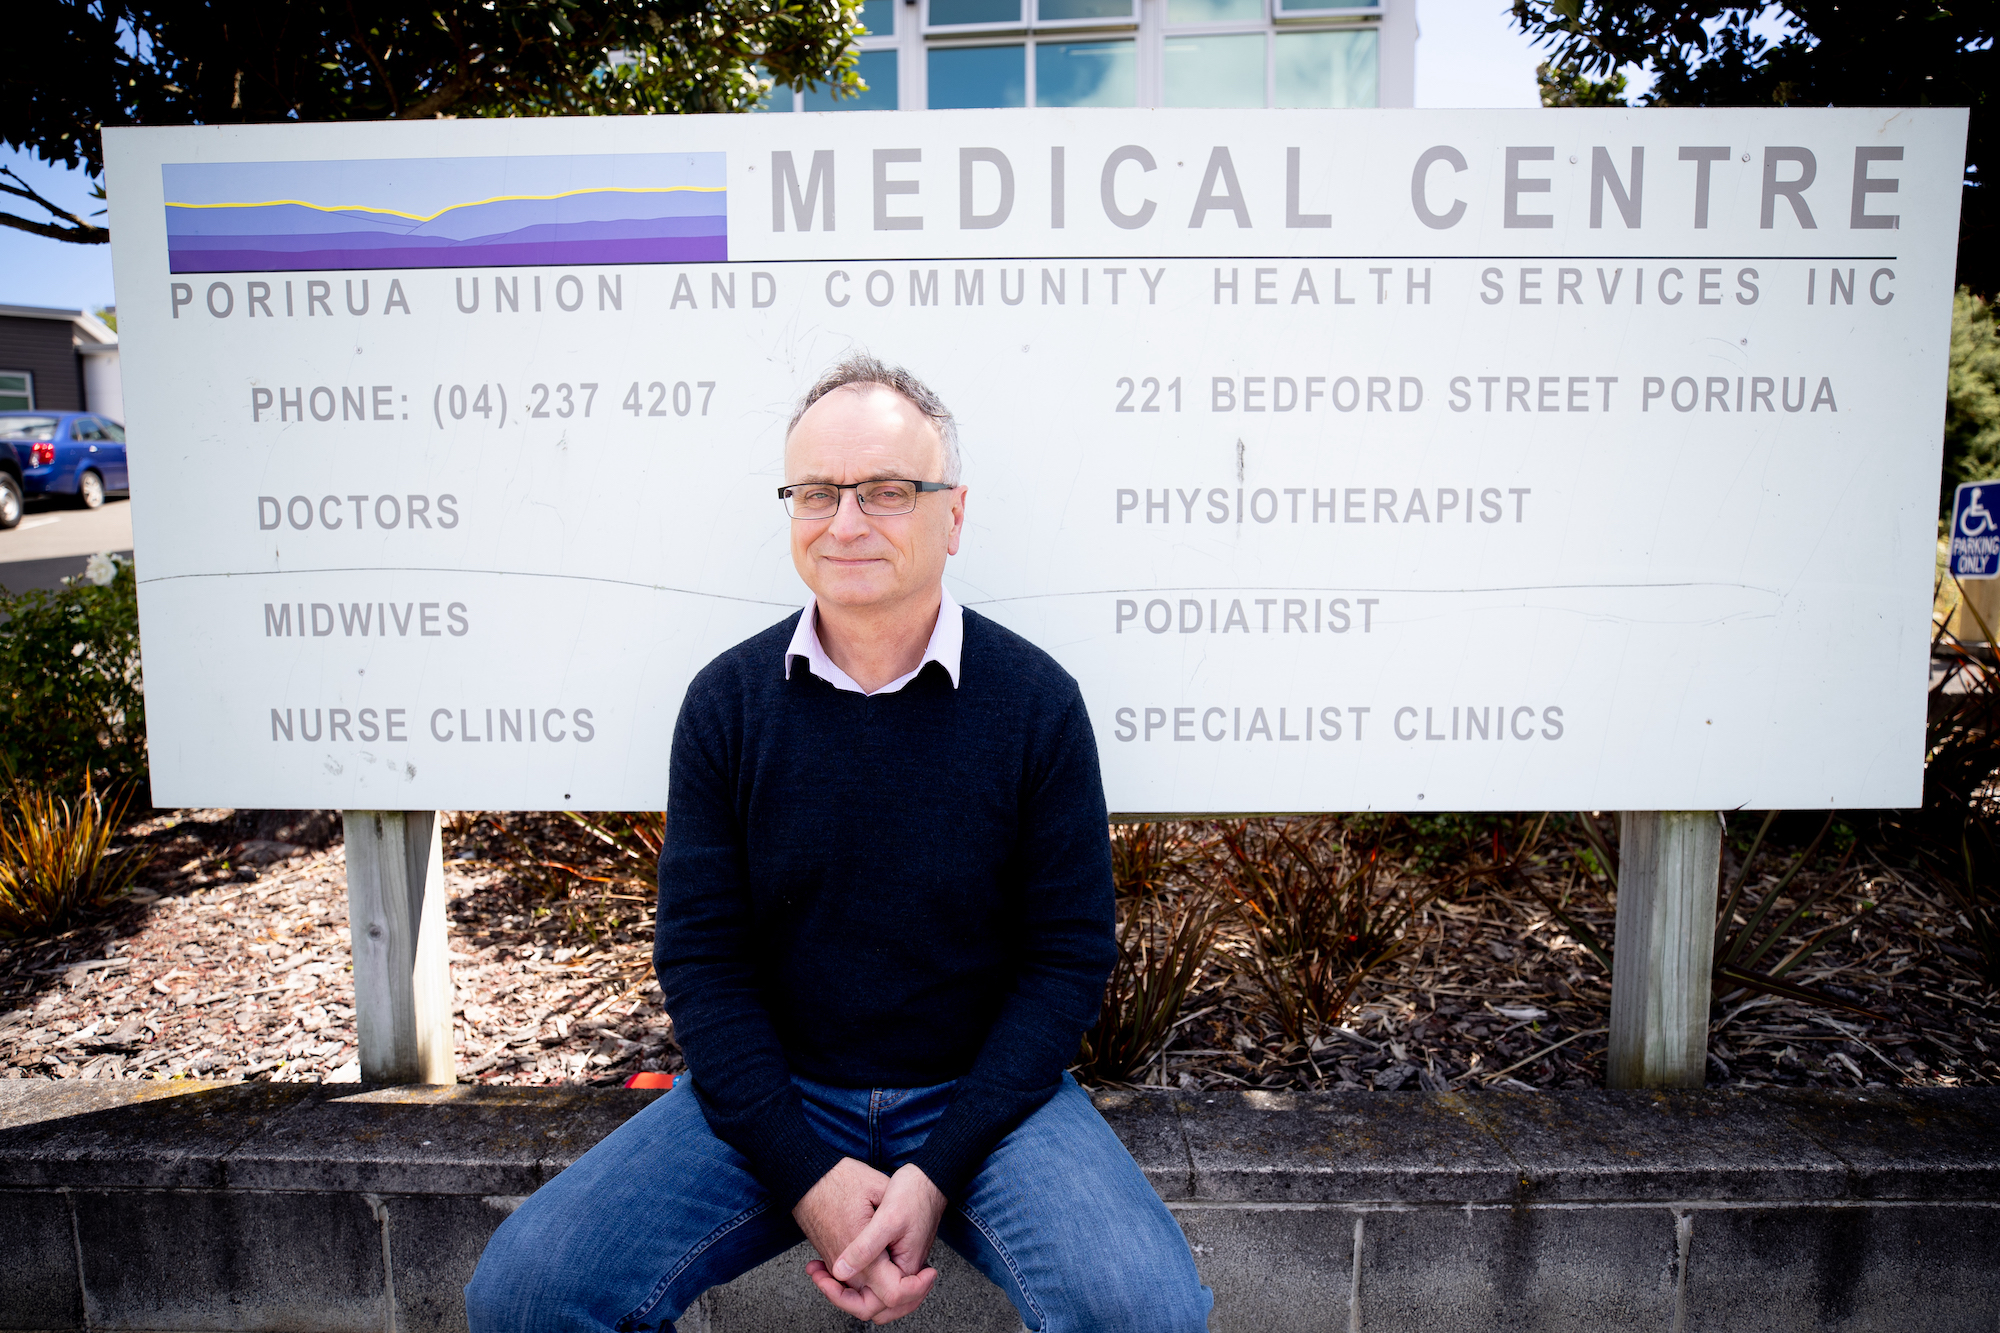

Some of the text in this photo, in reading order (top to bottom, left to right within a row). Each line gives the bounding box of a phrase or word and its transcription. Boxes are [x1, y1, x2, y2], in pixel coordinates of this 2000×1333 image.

[771, 144, 1905, 233] MEDICAL CENTRE
[170, 266, 1896, 320] PORIRUA UNION AND COMMUNITY HEALTH SERVICES INC
[251, 380, 716, 430] PHONE: (04) 237 4207
[1115, 375, 1838, 413] 221 BEDFORD STREET PORIRUA
[257, 493, 459, 531] DOCTORS
[1116, 487, 1532, 524] PHYSIOTHERAPIST
[1954, 536, 2000, 556] PARKING
[1958, 556, 1989, 574] ONLY
[263, 601, 469, 637] MIDWIVES
[1115, 598, 1380, 635] PODIATRIST
[270, 707, 595, 743] NURSE CLINICS
[1114, 705, 1564, 743] SPECIALIST CLINICS
